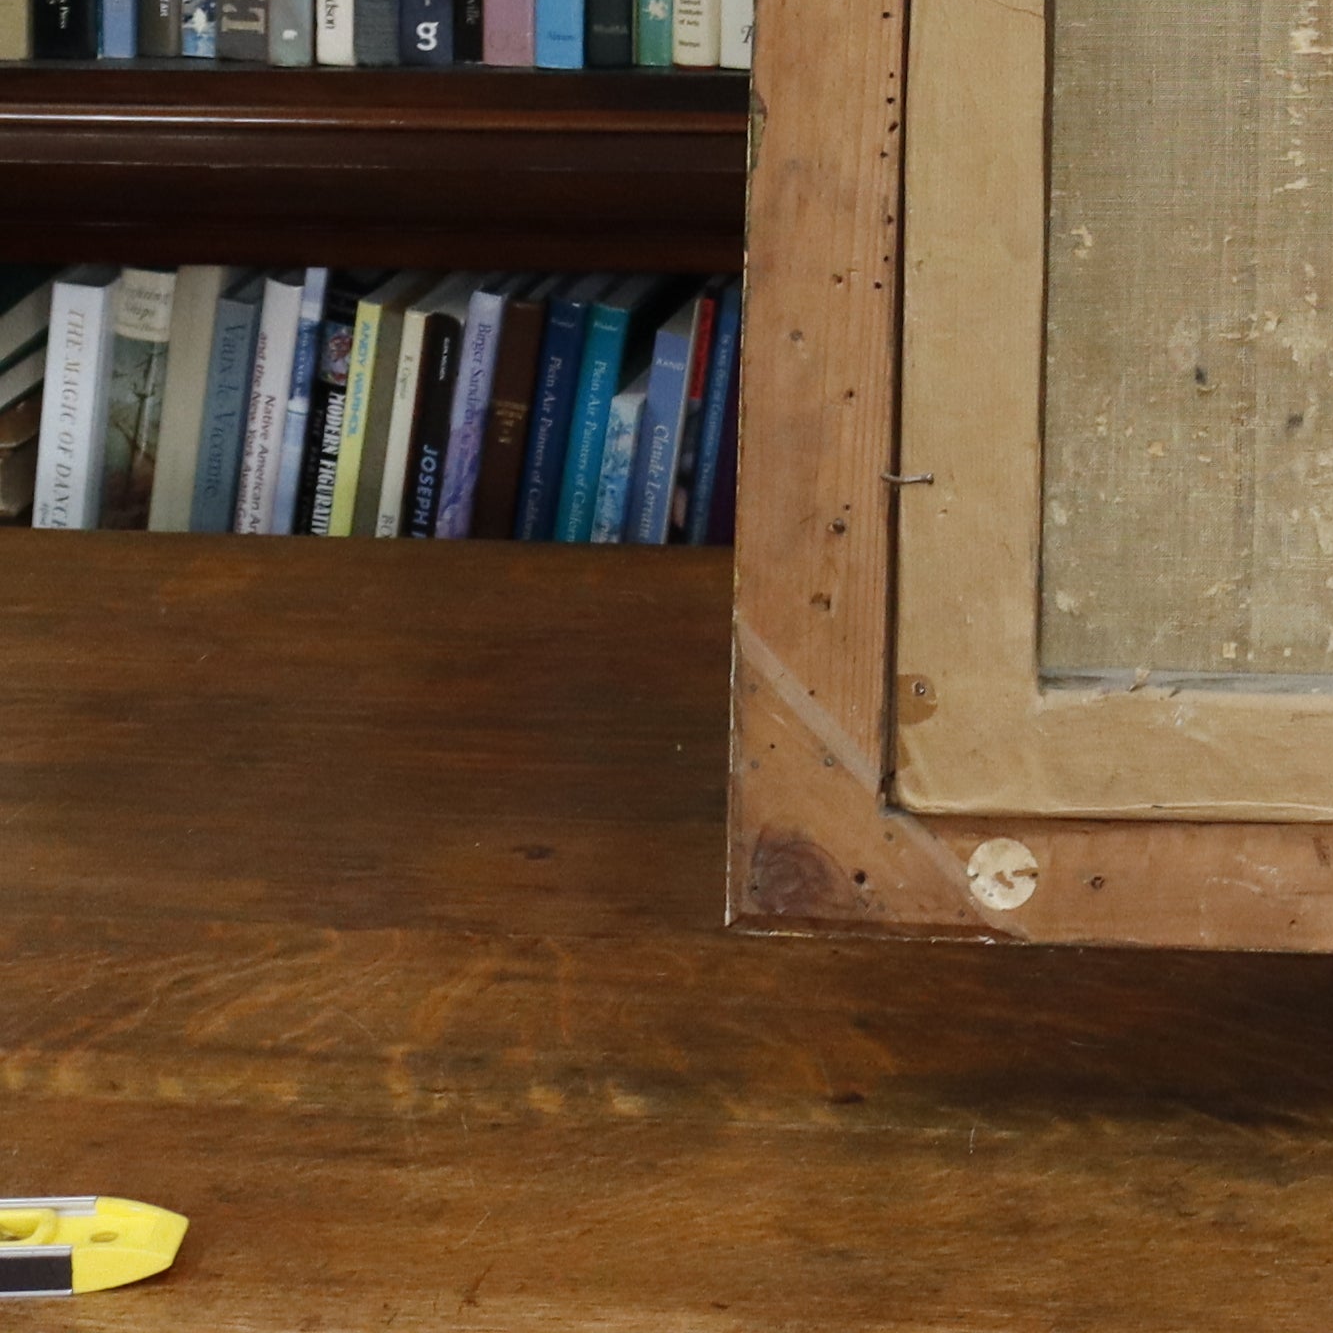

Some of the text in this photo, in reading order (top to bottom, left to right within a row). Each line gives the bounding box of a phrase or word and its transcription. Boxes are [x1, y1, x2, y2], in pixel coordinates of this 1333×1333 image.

[56, 308, 84, 456] THE MAGIC OF
[252, 363, 266, 387] the
[256, 331, 270, 360] and
[346, 320, 371, 437] ANDY WARHOL
[469, 322, 491, 364] Birger
[247, 390, 262, 424] New
[248, 395, 276, 510] Native American
[319, 390, 347, 455] MODERN
[530, 355, 562, 483] Plein Air Painters of
[576, 360, 609, 488] Plein Air Painters of
[409, 444, 441, 524] JOSEPH
[638, 424, 669, 539] Claude Lorrain
